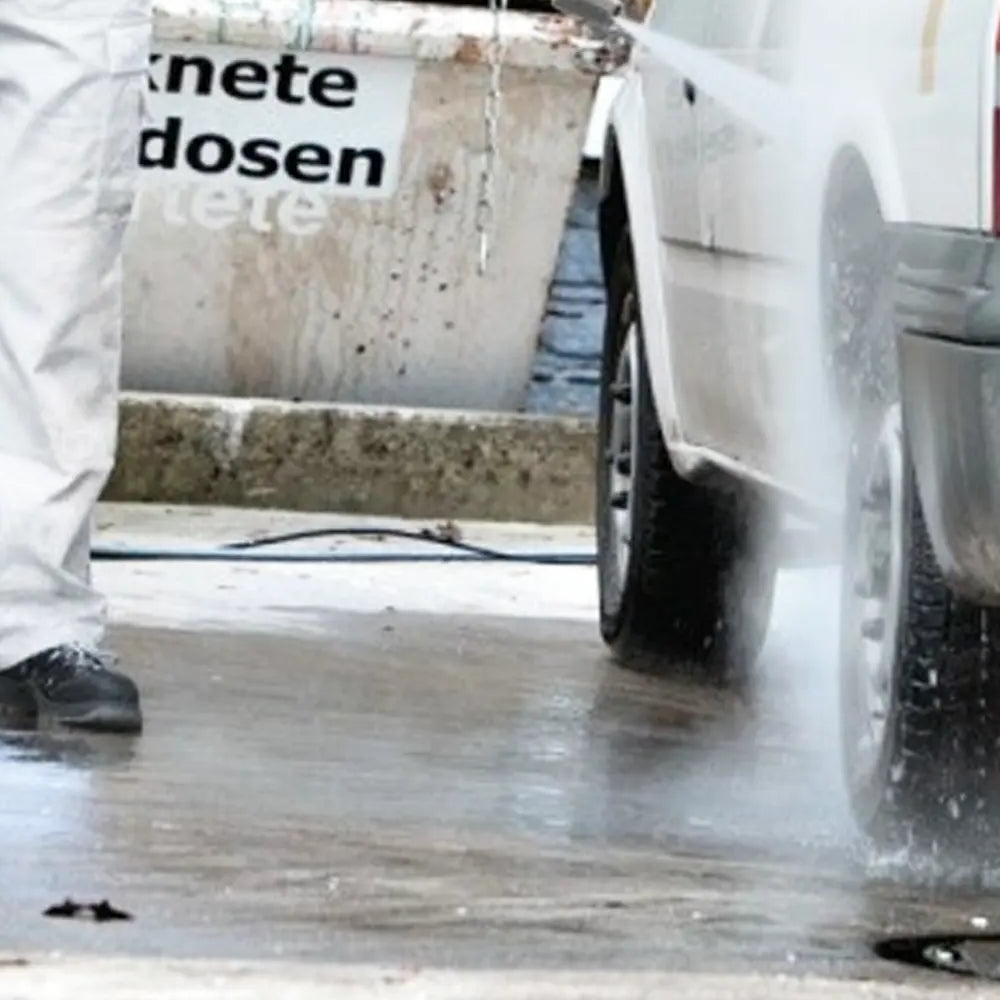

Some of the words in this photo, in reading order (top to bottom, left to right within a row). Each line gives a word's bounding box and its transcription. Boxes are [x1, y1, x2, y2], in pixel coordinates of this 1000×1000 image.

[149, 53, 358, 109] nete
[138, 116, 385, 187] dosen
[162, 184, 329, 236] tete
